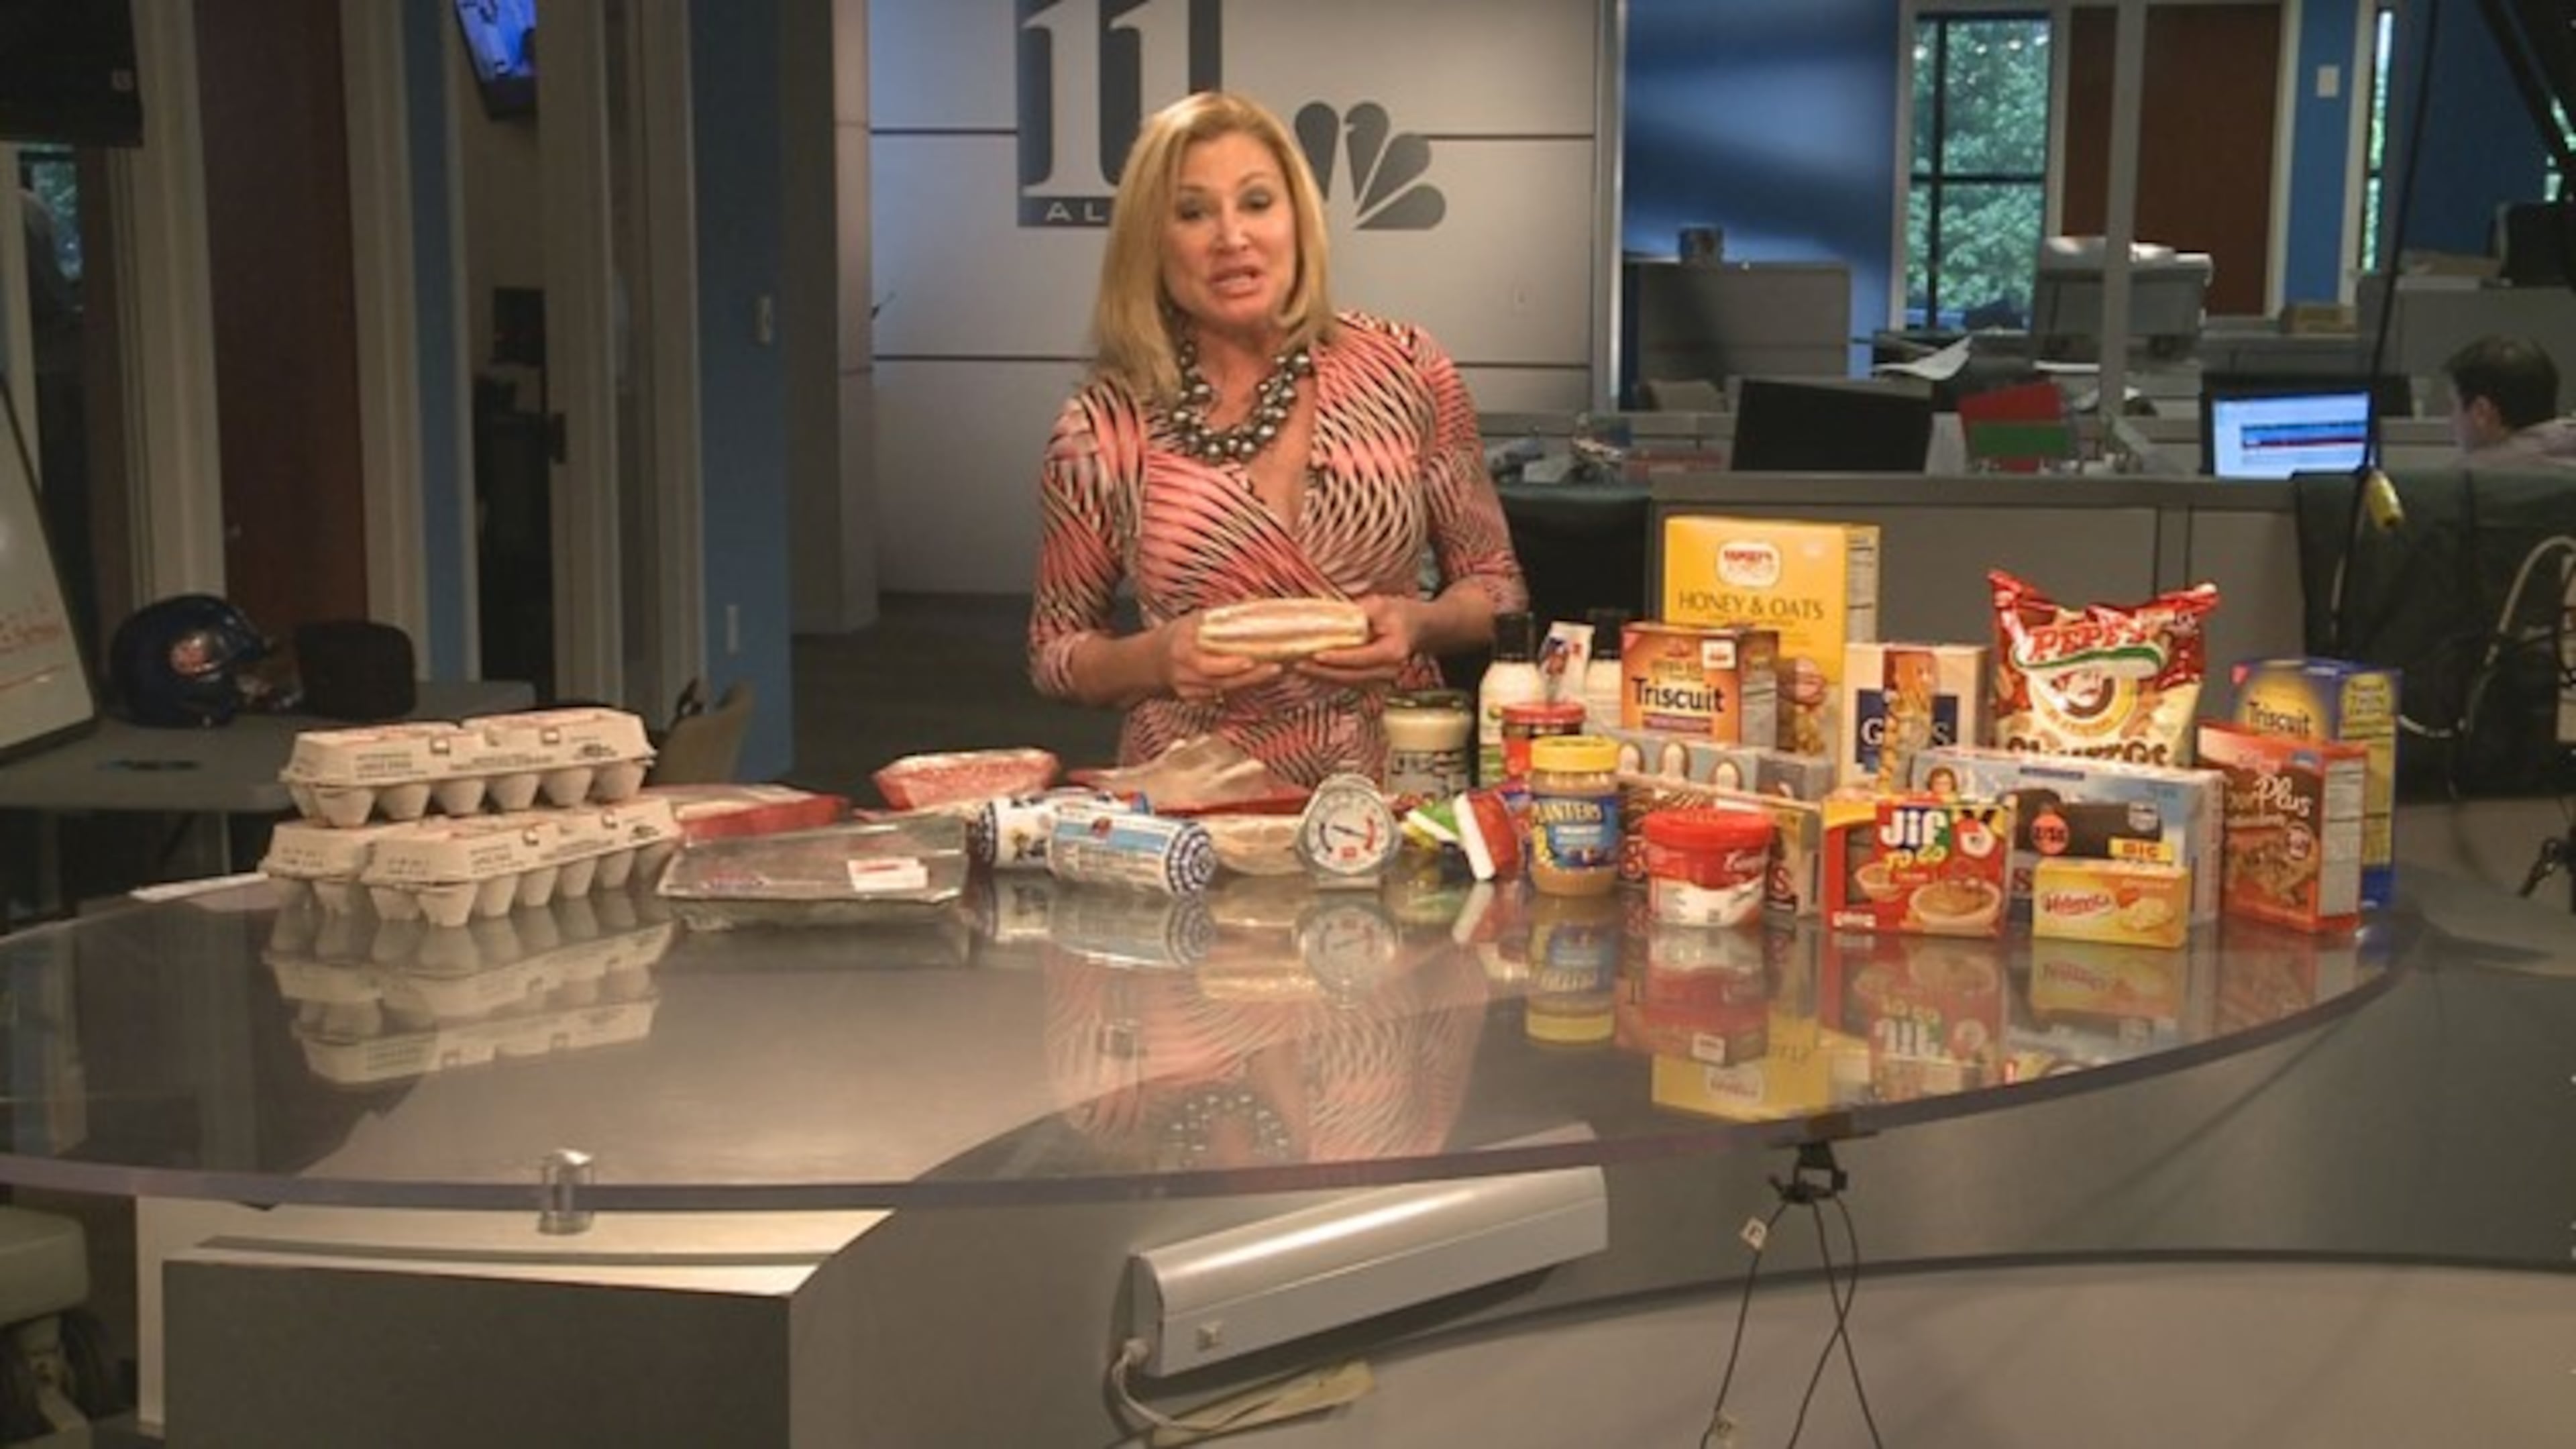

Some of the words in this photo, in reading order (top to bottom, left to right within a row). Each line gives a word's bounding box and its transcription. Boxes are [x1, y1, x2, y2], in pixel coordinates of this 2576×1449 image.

[1678, 590, 1744, 614] HONEY
[1748, 594, 1763, 616] &
[1769, 598, 1825, 620] OATS
[1631, 676, 1725, 712] Triscuit
[2247, 701, 2310, 735] Triscuit
[2253, 774, 2312, 818] Plus
[1880, 810, 1948, 849] Jif
